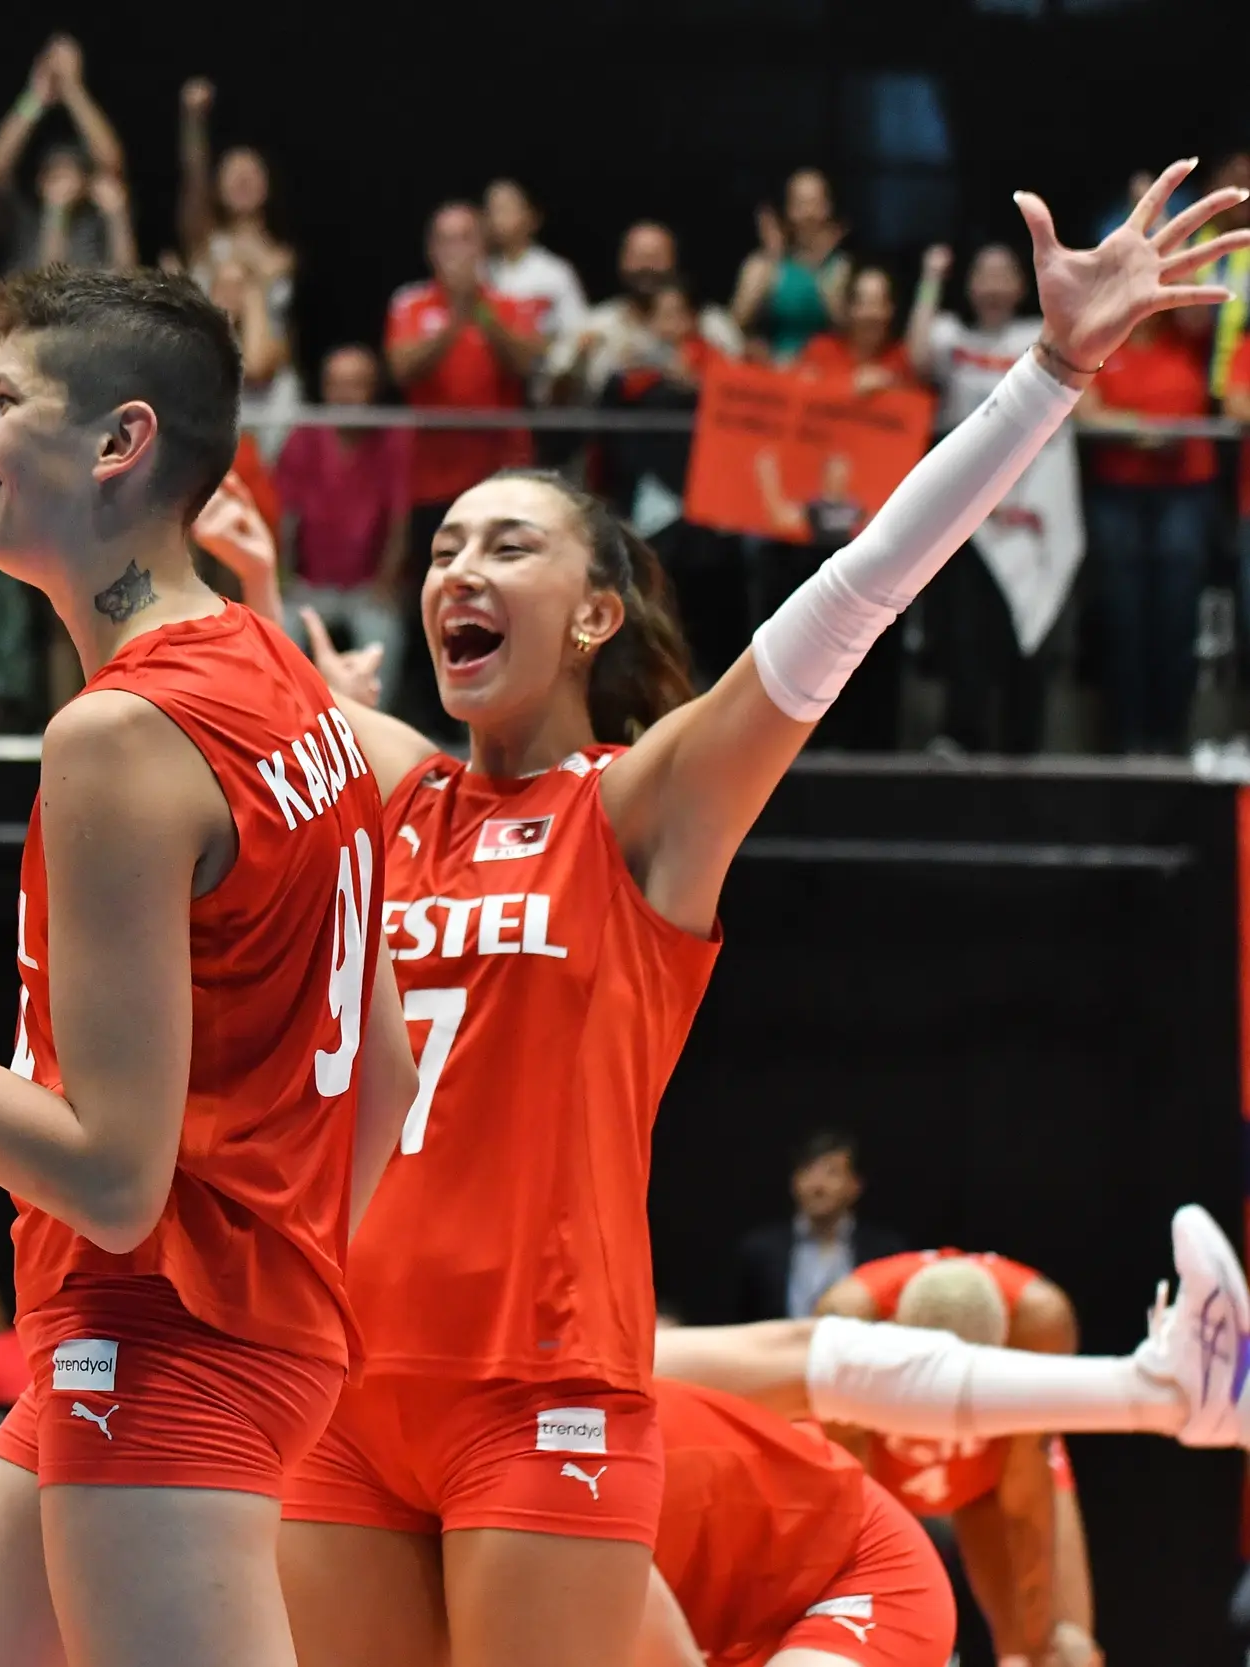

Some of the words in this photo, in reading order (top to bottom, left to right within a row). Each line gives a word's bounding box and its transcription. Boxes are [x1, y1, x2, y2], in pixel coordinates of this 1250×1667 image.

[381, 893, 568, 961] ESTEL
[401, 987, 468, 1156] 7
[55, 1357, 113, 1375] trendyol
